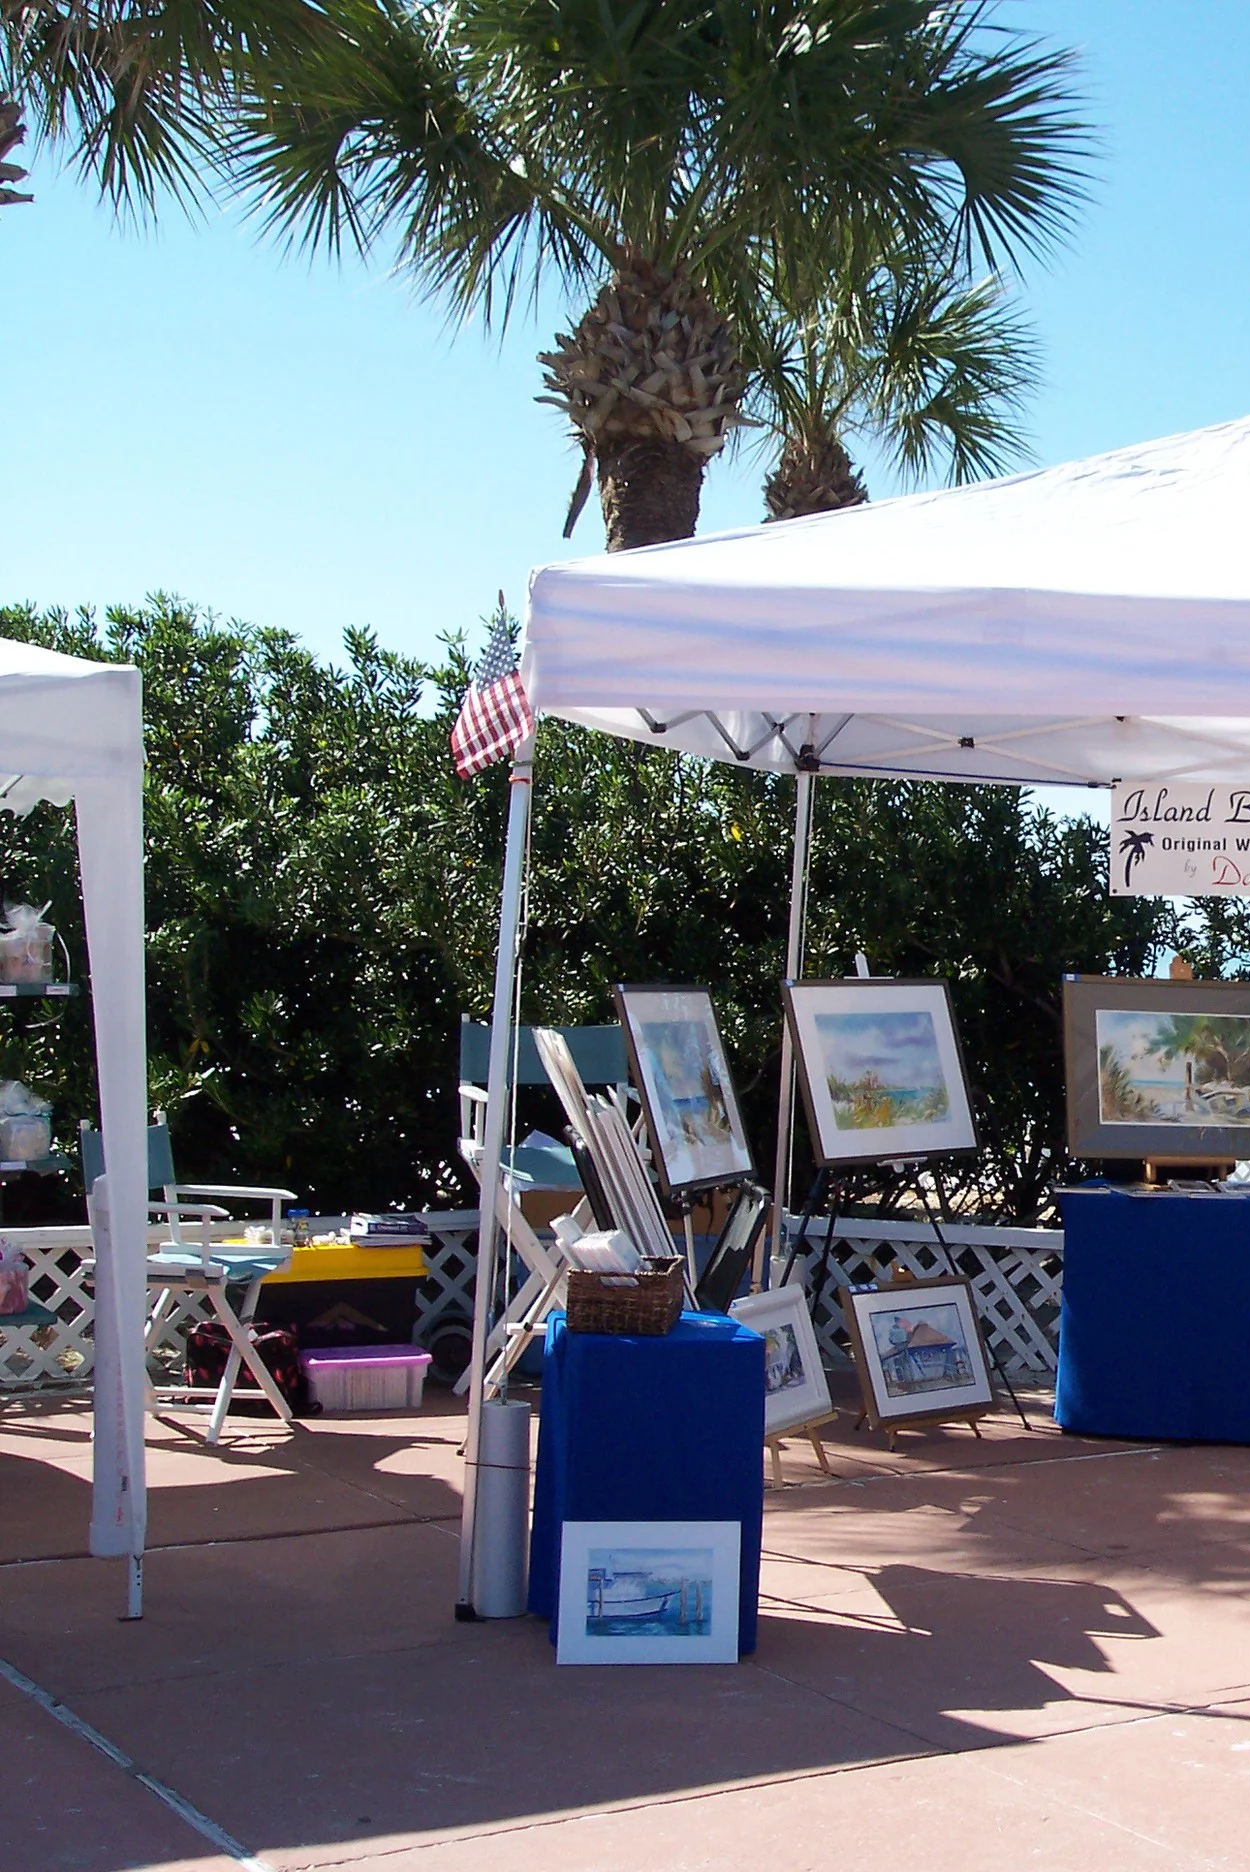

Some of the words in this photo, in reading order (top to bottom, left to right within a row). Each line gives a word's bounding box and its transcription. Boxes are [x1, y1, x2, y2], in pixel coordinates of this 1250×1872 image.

[1116, 787, 1215, 823] Island
[1161, 836, 1227, 853] Original
[1183, 858, 1197, 878] by
